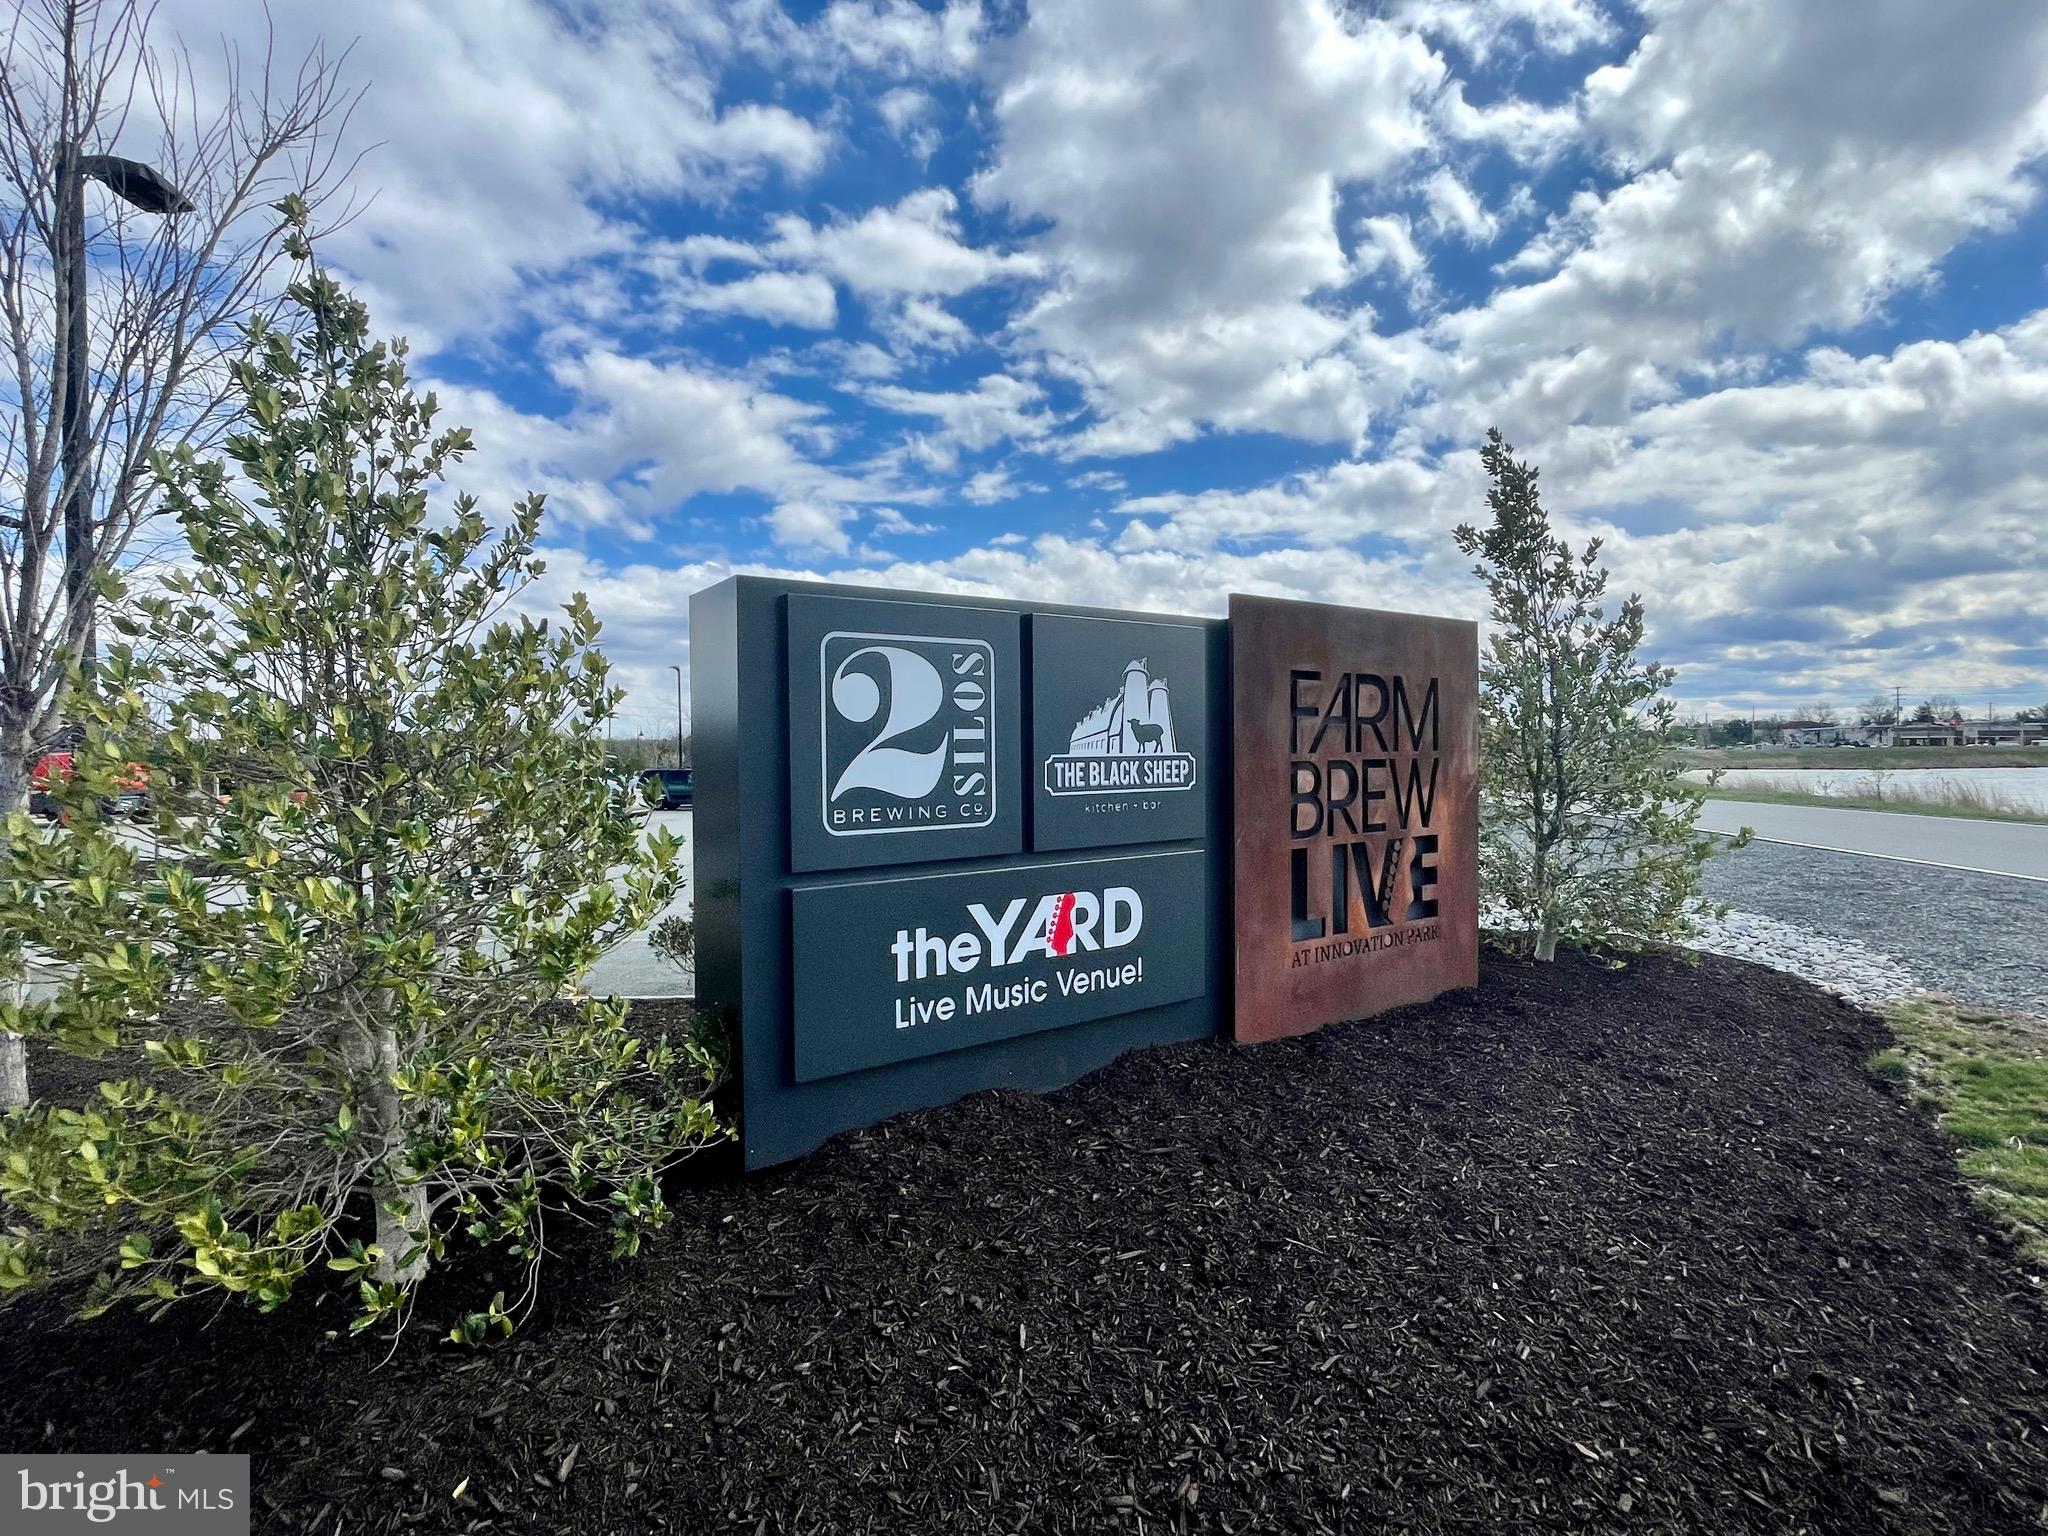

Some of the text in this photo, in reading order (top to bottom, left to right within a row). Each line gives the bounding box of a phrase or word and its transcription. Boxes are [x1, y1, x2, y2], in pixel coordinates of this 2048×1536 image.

[831, 646, 949, 802] 2
[952, 651, 986, 797] SILOS
[1290, 669, 1439, 753] FARM
[1054, 760, 1189, 788] THE BLACK SHEEP
[1084, 802, 1129, 813] kitchen
[1143, 801, 1162, 810] bar
[1290, 757, 1439, 840] BREW
[833, 804, 947, 824] BREWING
[1291, 834, 1439, 942] LIVE
[1291, 925, 1440, 968] AT INNOVATION PARK
[895, 957, 1143, 1029] Live Music Venue!
